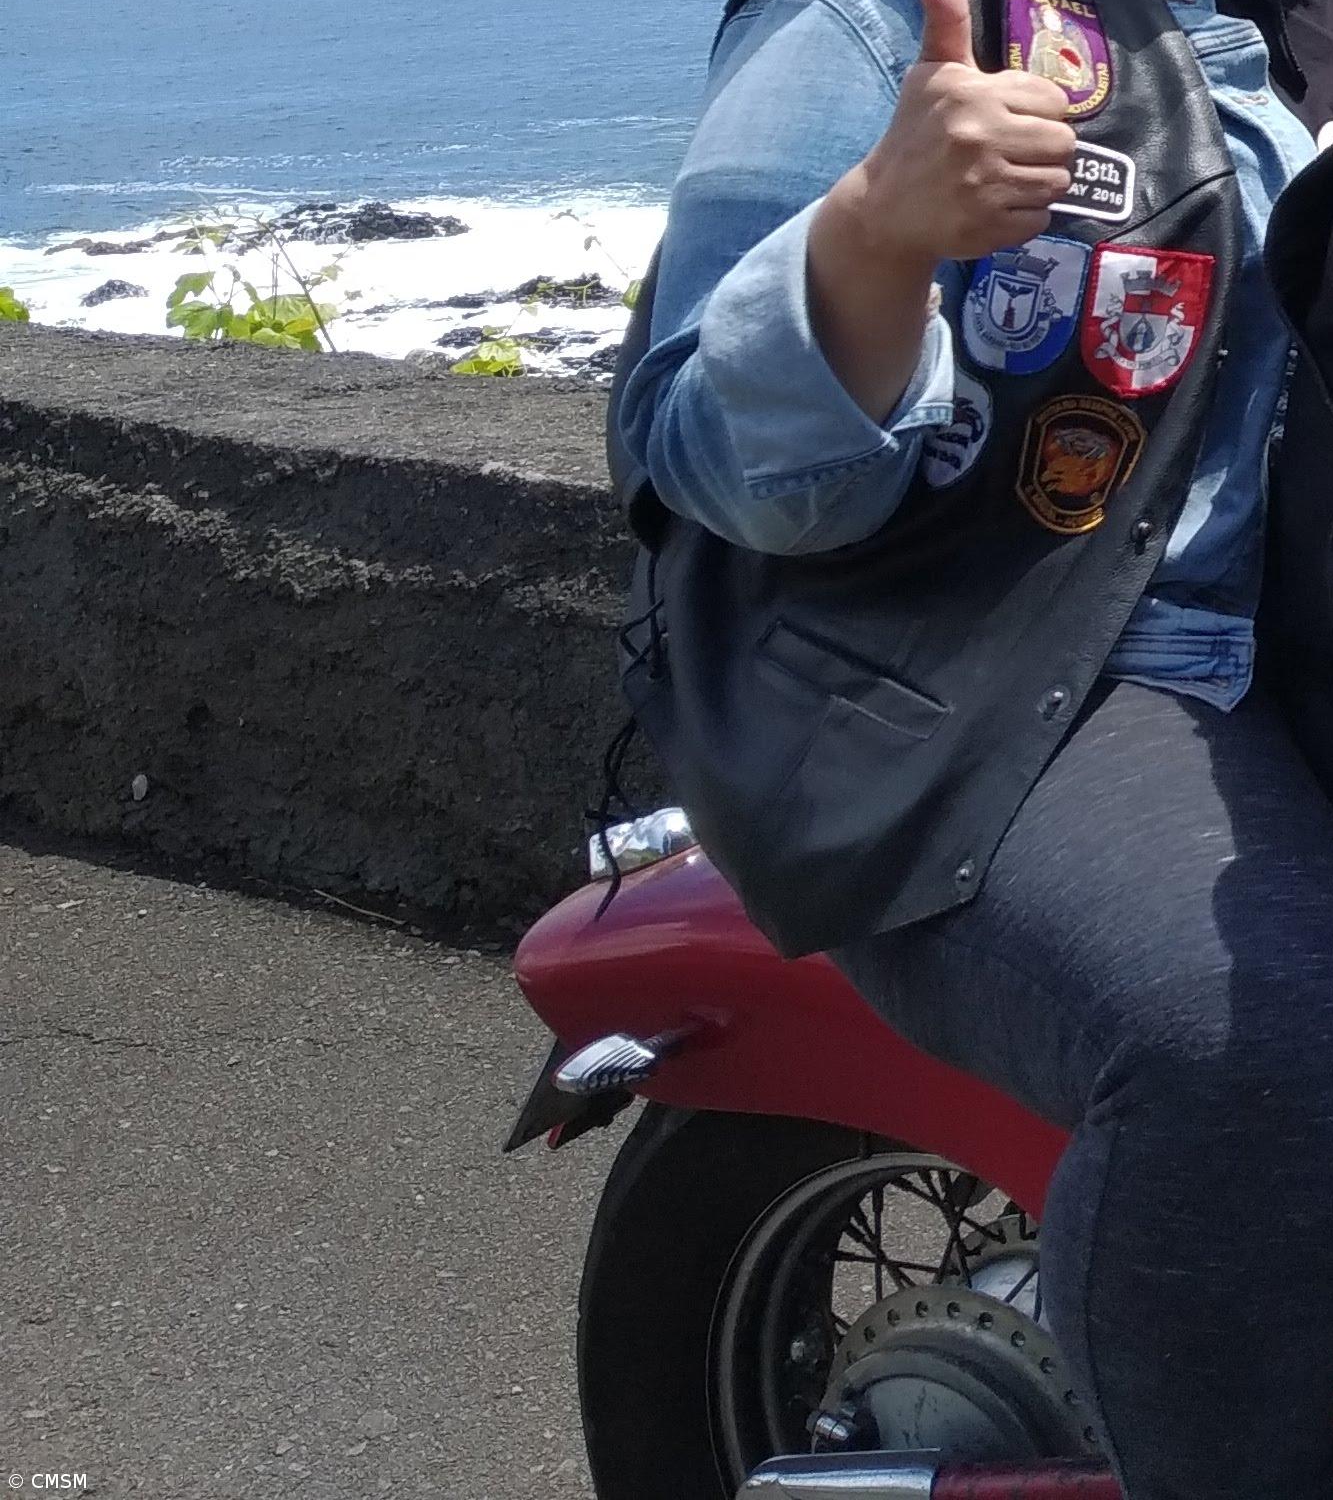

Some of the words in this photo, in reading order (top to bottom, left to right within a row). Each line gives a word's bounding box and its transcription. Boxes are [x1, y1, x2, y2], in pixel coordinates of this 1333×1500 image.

[1074, 157, 1122, 186] 13th
[1066, 182, 1089, 197] AY
[1091, 187, 1124, 206] 2016
